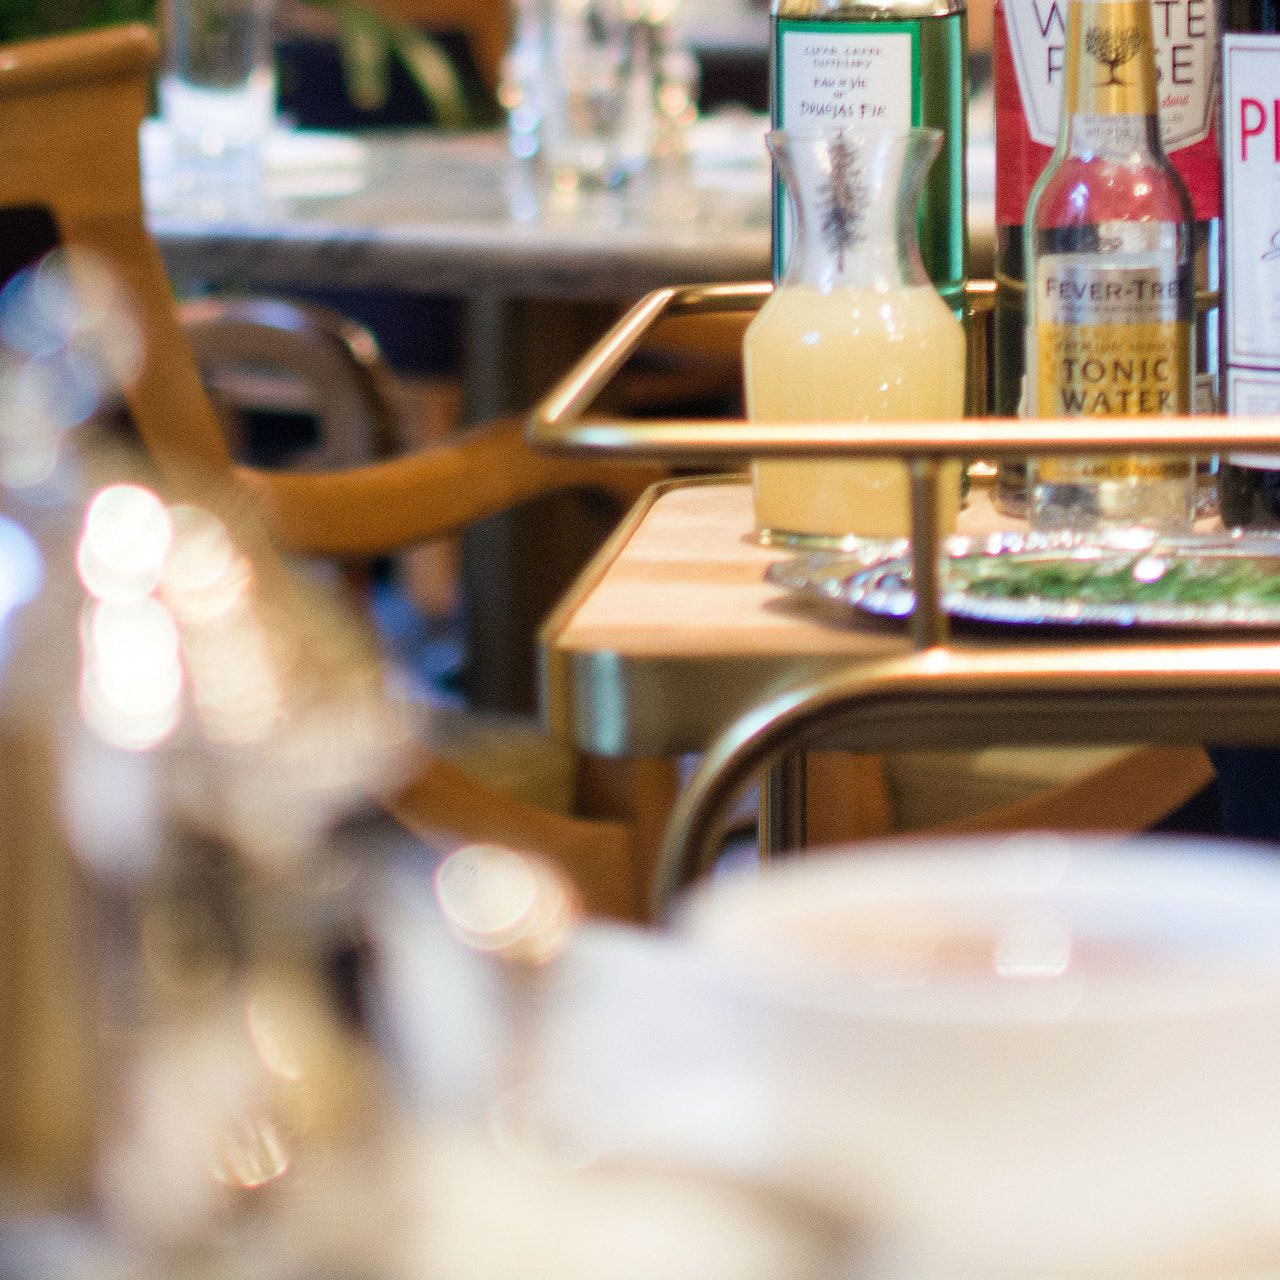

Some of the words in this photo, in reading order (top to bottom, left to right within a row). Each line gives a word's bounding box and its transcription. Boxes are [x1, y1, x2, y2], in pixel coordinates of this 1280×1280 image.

[800, 101, 854, 119] DOUGLAS
[1045, 277, 1180, 302] FEVER-TRE
[1062, 357, 1169, 384] TONIC
[1061, 388, 1171, 415] WATER
